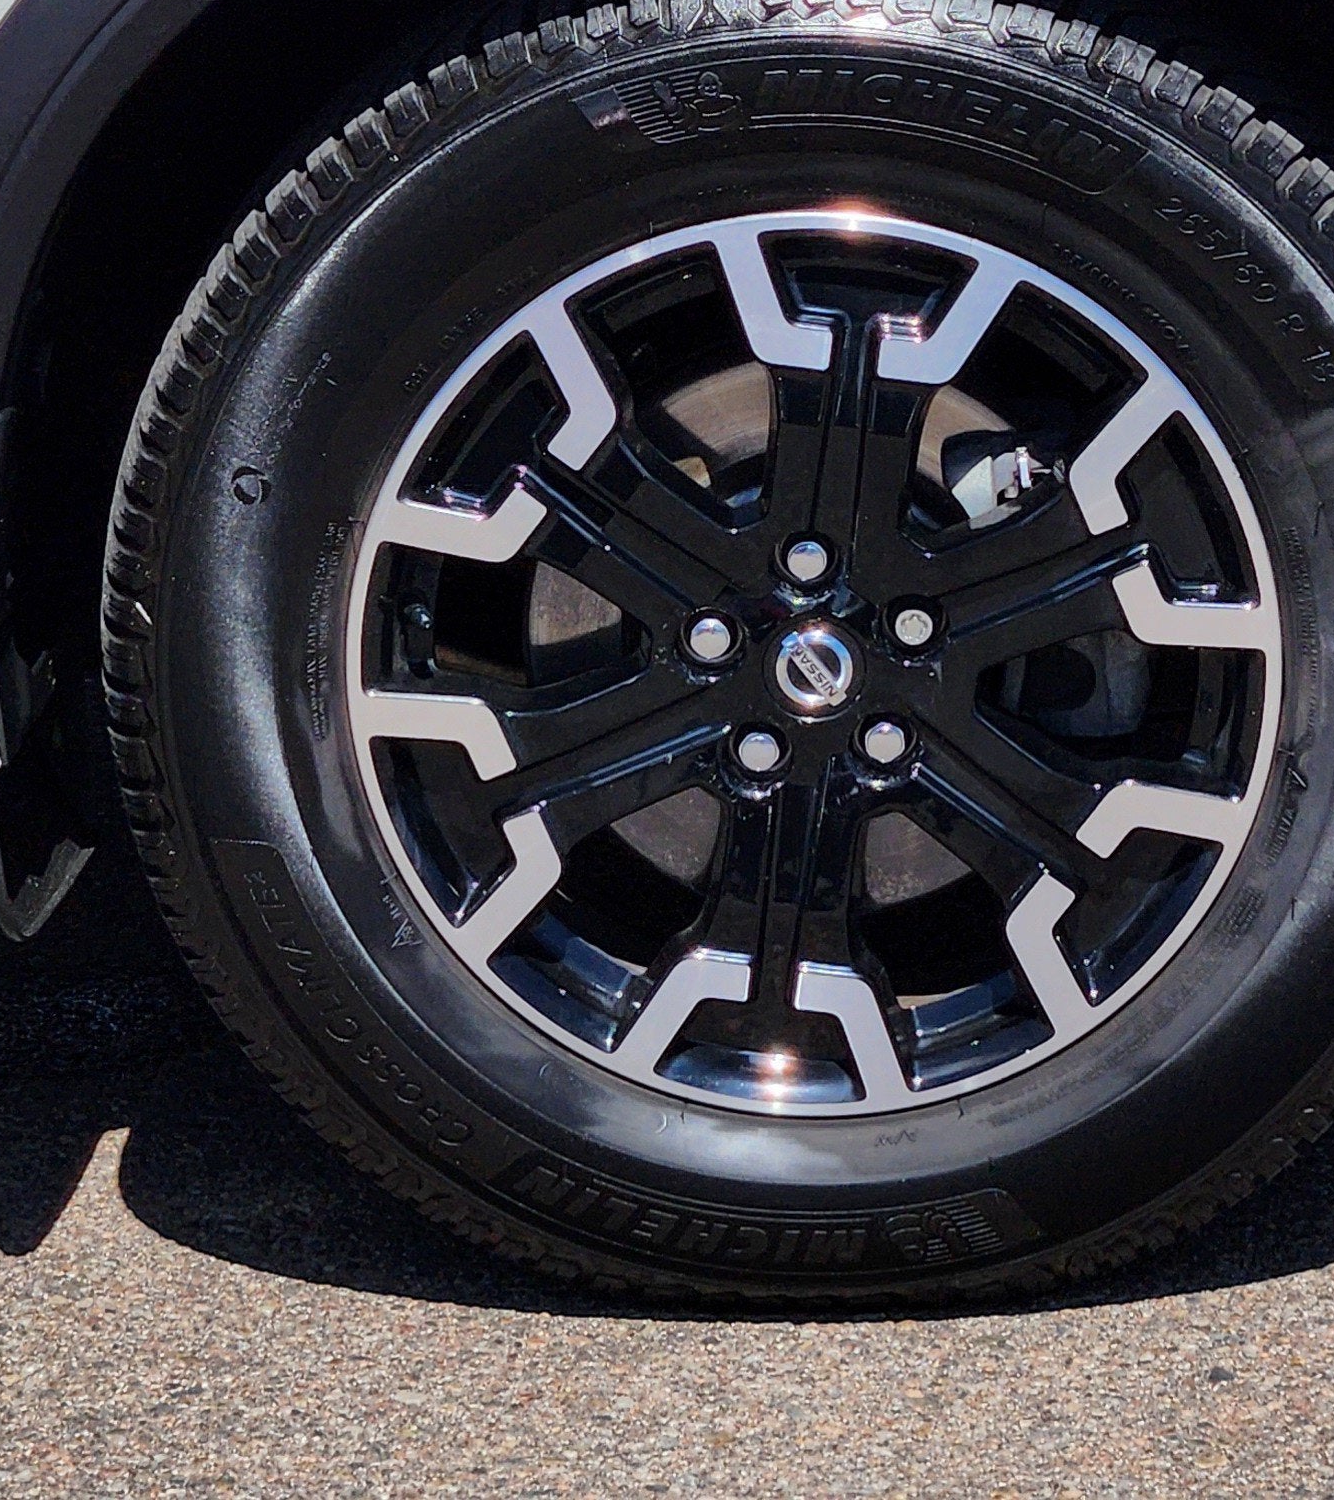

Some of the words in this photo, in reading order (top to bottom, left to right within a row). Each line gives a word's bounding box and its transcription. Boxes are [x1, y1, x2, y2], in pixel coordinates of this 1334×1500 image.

[756, 67, 1122, 168] MICHELIN
[790, 645, 839, 697] NISSAN
[512, 1165, 867, 1266] MICHELIN
